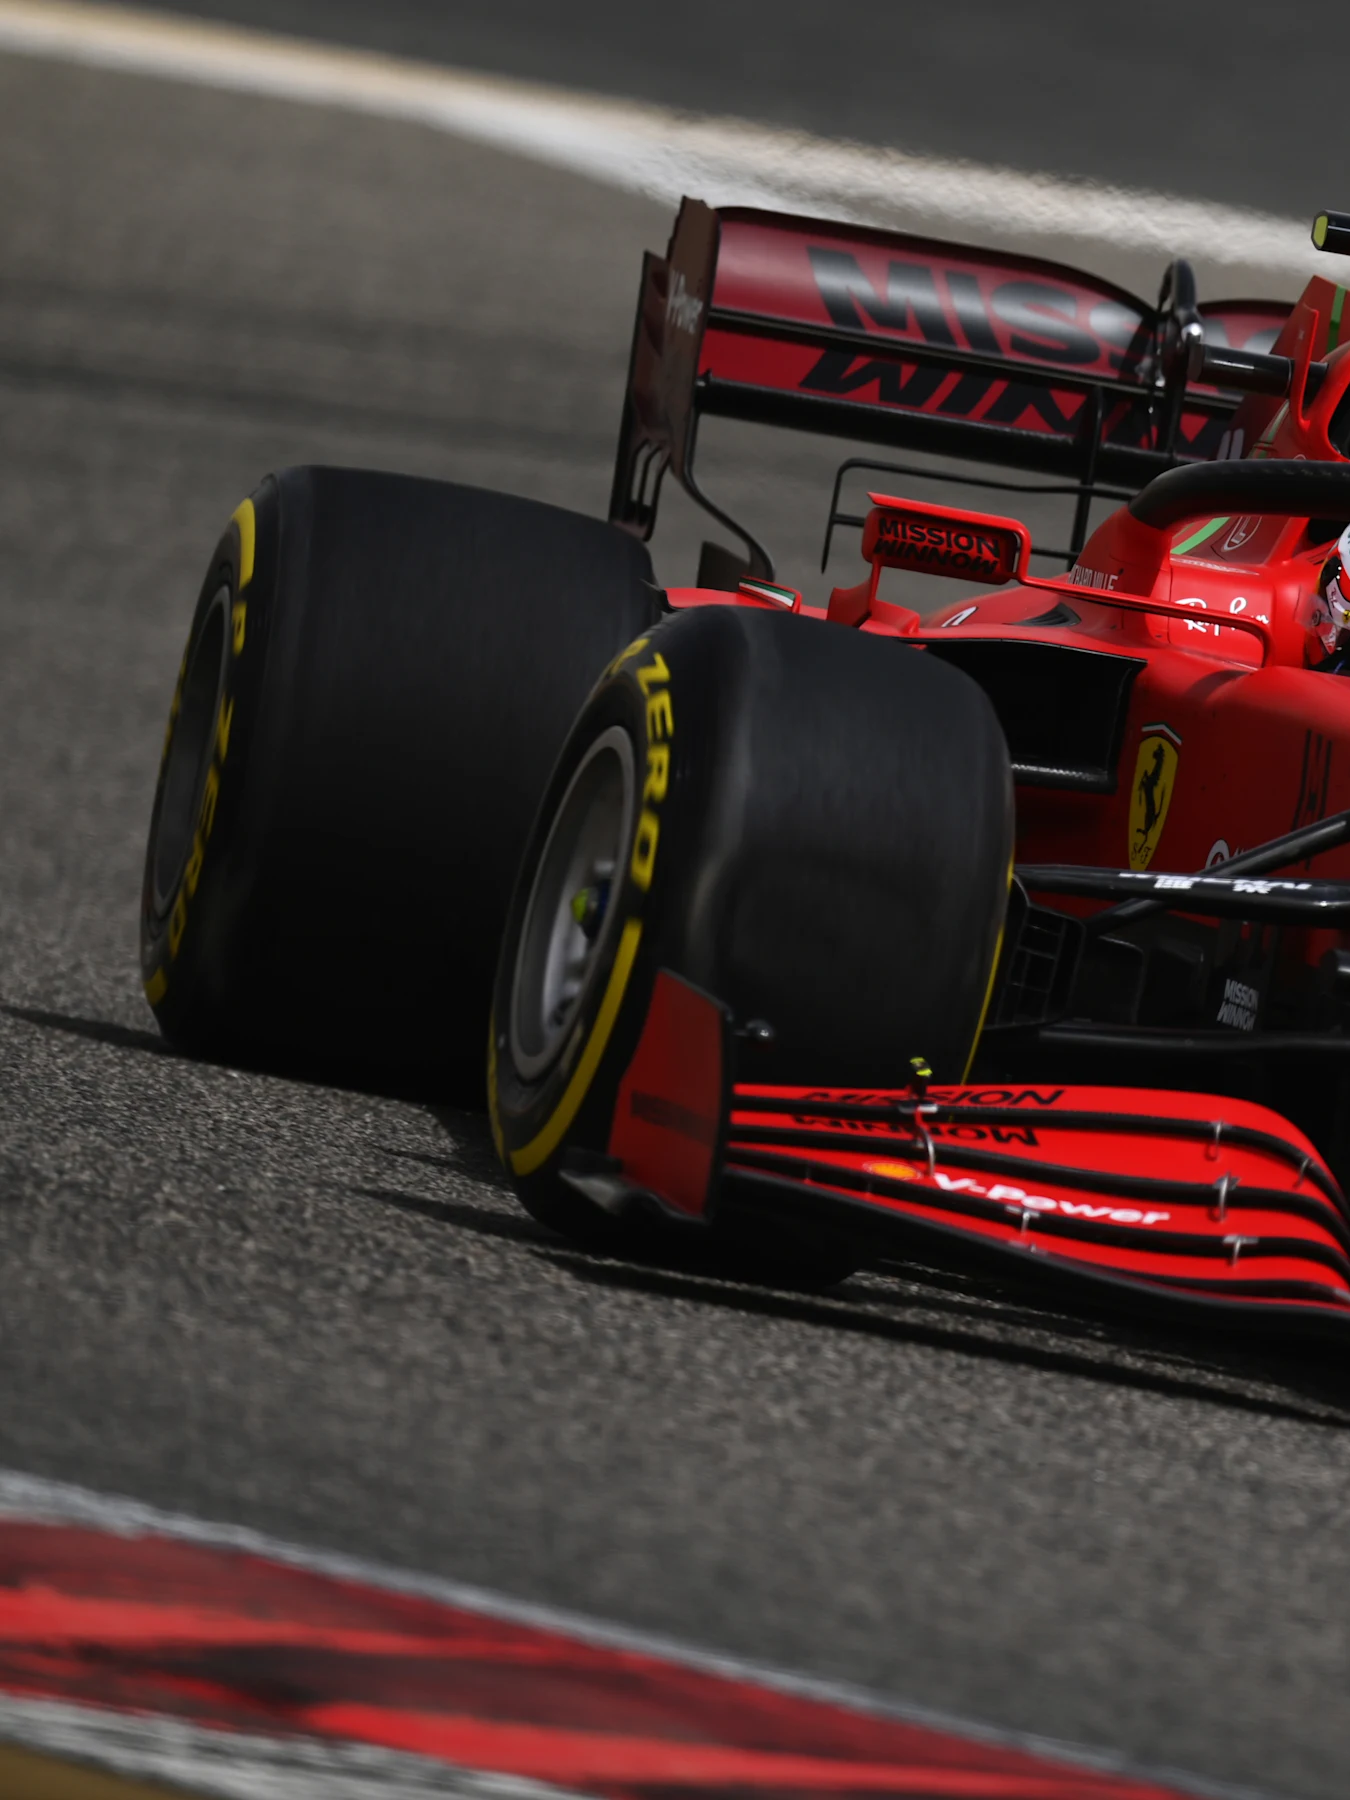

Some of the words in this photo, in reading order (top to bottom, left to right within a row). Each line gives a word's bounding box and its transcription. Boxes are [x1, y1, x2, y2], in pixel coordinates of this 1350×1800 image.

[873, 538, 999, 575] WINNOW
[879, 517, 1000, 558] MISSION
[629, 651, 676, 894] ZERO
[1223, 978, 1260, 1013] MISSION
[933, 1171, 1172, 1225] V-Power
